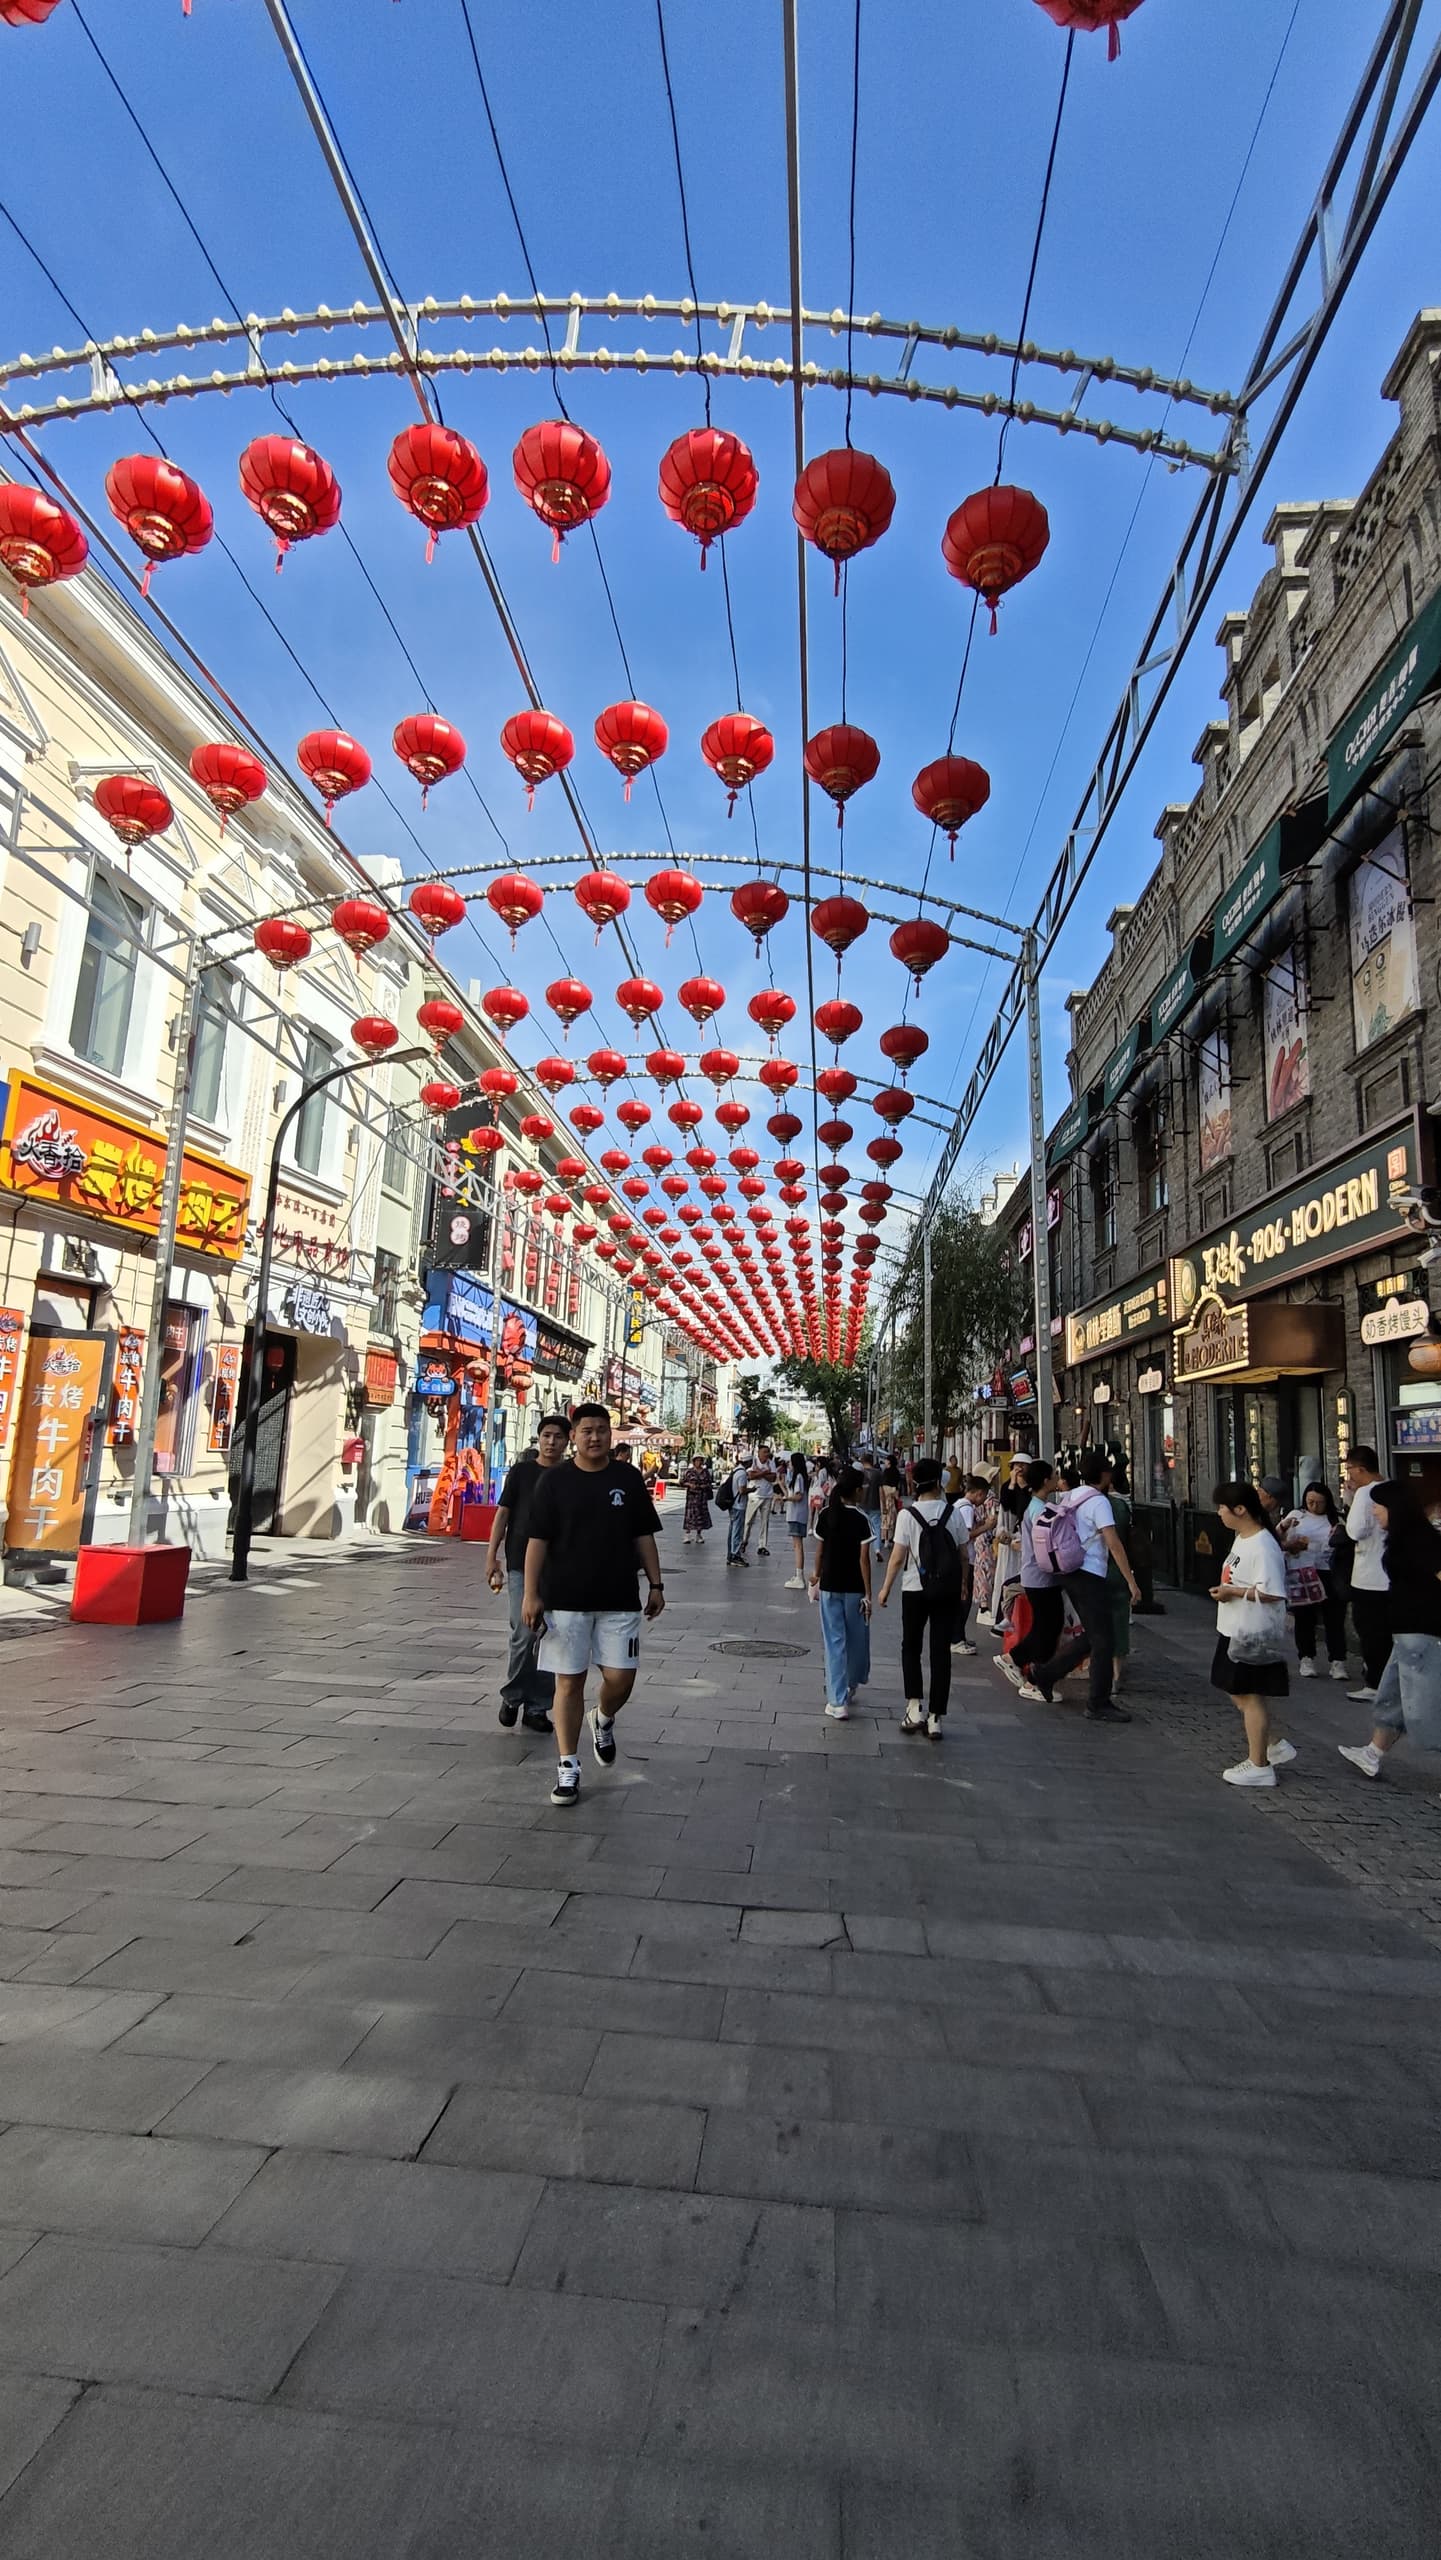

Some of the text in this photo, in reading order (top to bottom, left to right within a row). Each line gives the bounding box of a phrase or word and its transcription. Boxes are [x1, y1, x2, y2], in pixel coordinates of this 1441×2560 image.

[20, 1138, 85, 1170] 火香拾
[79, 1139, 241, 1239] 炭烤肉干
[1292, 1168, 1379, 1247] MODERN
[1365, 1306, 1425, 1340] 奶香烤馒头
[1191, 1335, 1238, 1370] MODERN
[32, 1381, 84, 1410] 炭烤
[113, 1368, 137, 1442] 牛肉干
[24, 1416, 70, 1541] 牛肉干
